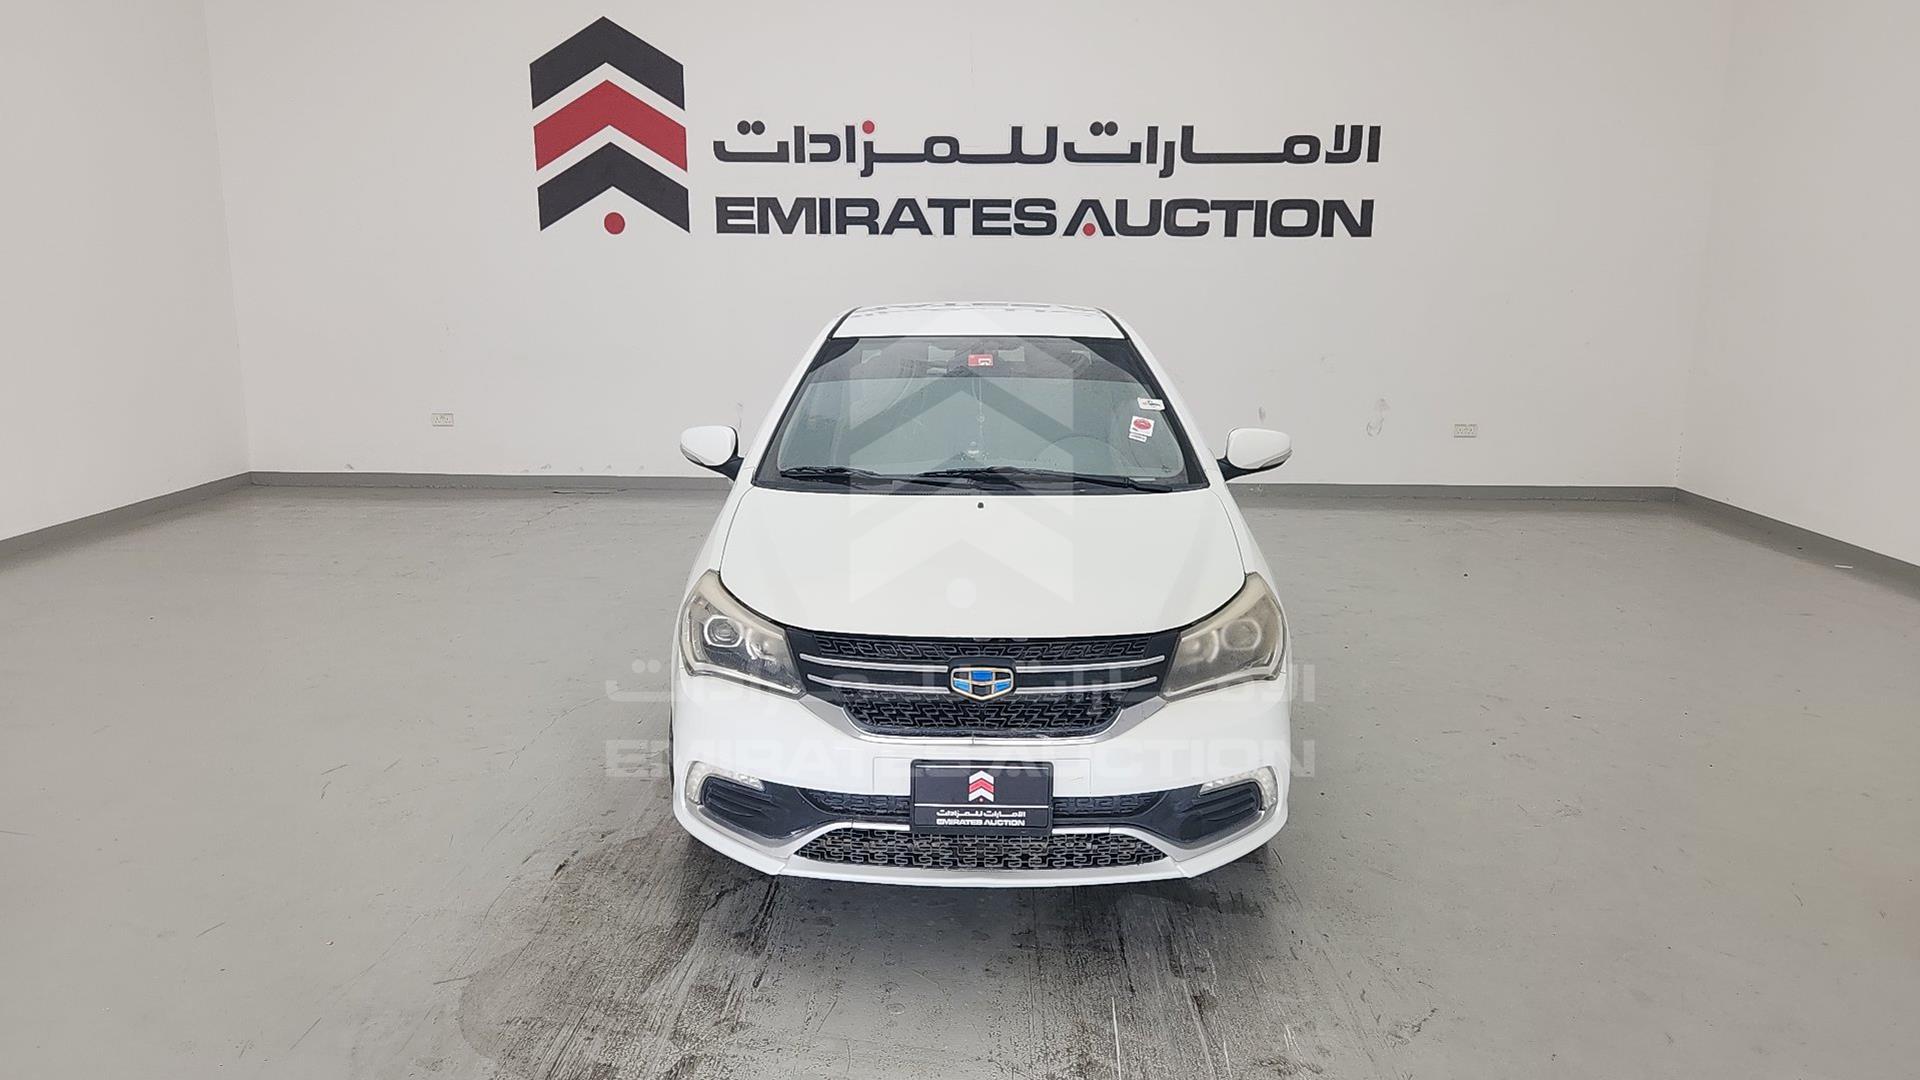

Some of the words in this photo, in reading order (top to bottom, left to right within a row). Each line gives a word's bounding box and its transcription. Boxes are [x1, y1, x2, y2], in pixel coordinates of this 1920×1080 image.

[712, 120, 1058, 178] للمزادات
[1063, 120, 1382, 179] الامارات
[715, 196, 1057, 237] EMIRATES
[1062, 197, 1375, 238] AUCTION
[936, 818, 983, 826] EMIRATES
[983, 819, 1026, 827] AUCTION
